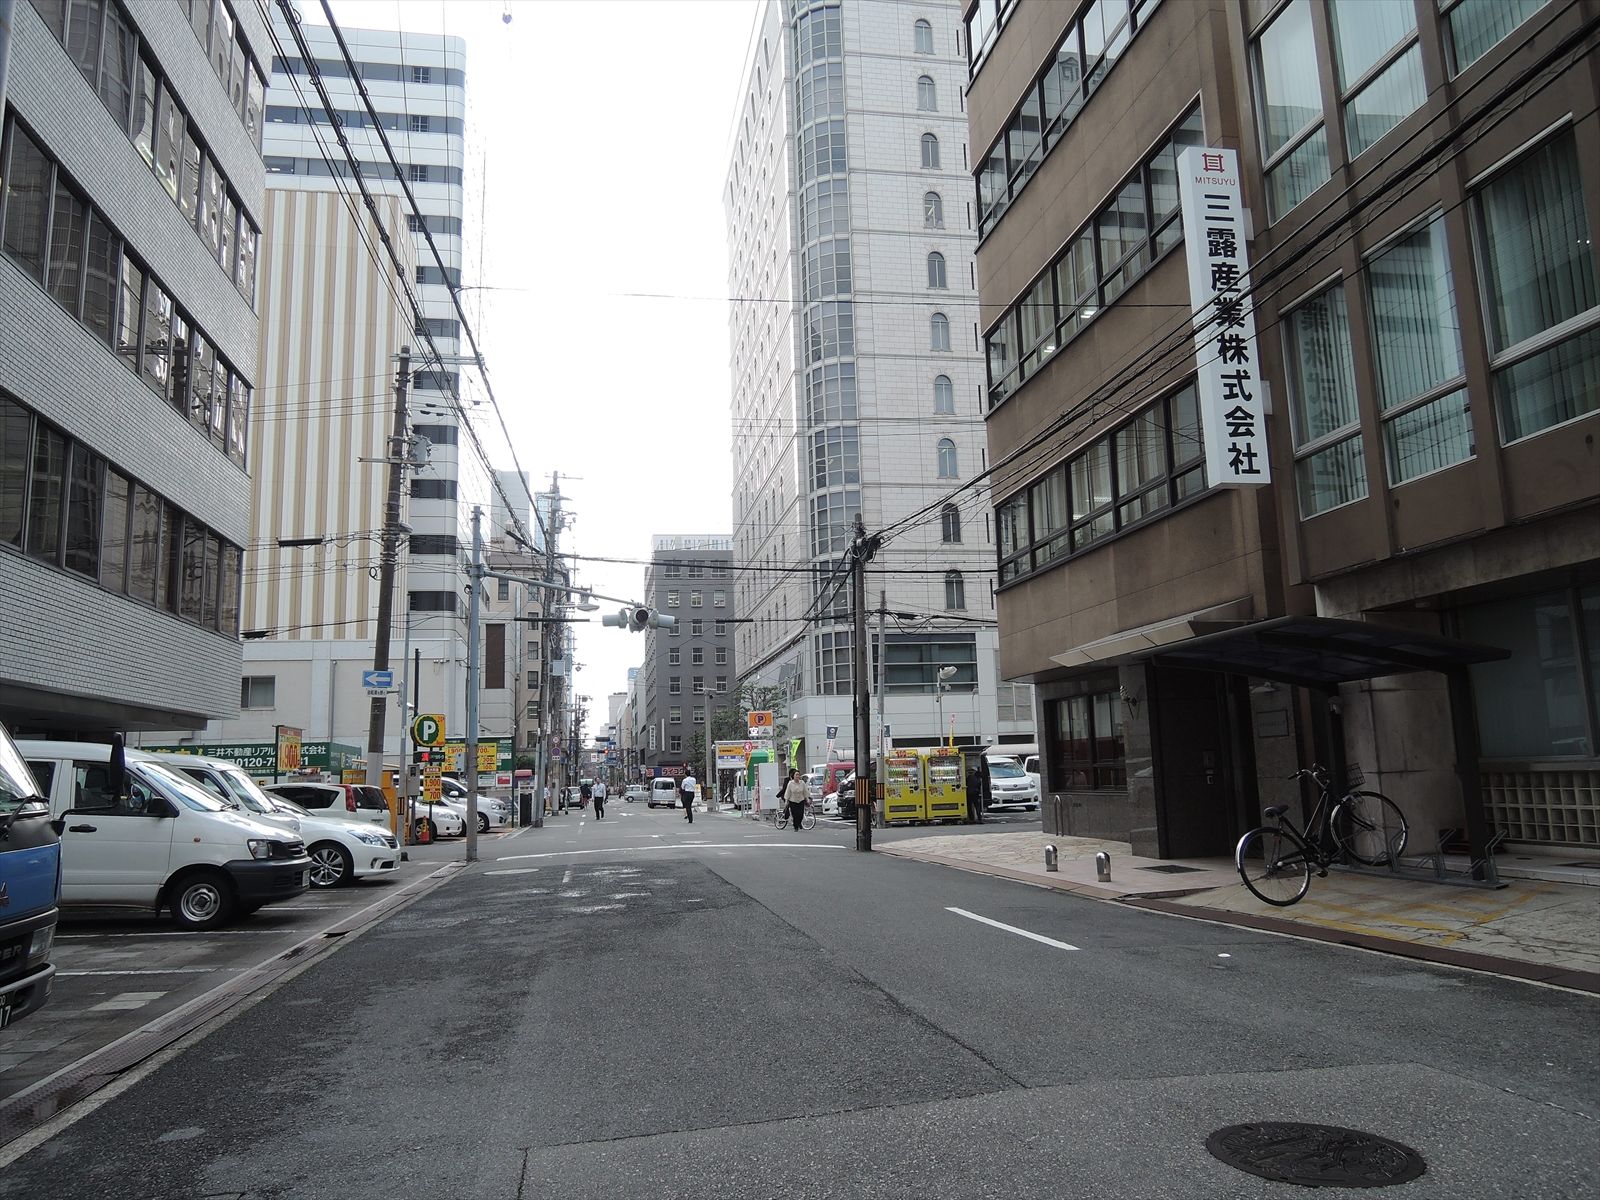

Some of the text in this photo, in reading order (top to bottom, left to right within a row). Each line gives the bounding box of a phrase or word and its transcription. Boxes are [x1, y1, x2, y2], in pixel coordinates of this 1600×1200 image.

[1195, 176, 1236, 186] MITSUYU
[1204, 194, 1261, 475] 三露産業株式会社
[423, 720, 436, 741] P
[425, 779, 441, 788] 1,900
[429, 791, 440, 799] 700
